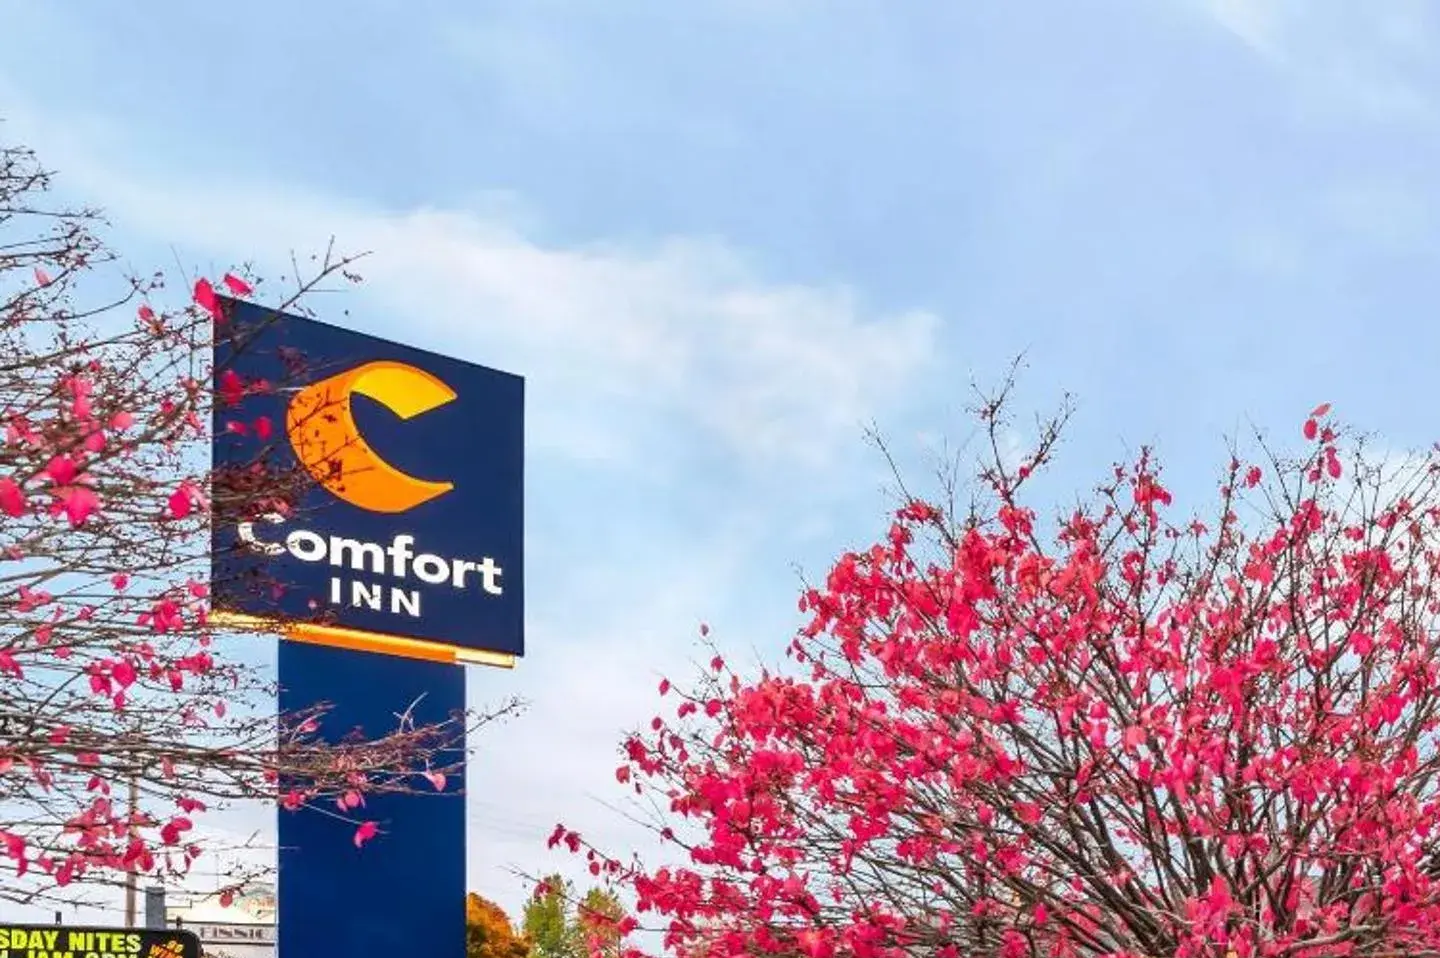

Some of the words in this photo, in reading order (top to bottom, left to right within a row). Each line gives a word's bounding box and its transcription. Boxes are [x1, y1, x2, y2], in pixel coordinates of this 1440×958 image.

[237, 512, 503, 595] Comfort
[330, 577, 421, 617] INN
[0, 928, 59, 951] SDAY
[69, 931, 142, 954] NITES
